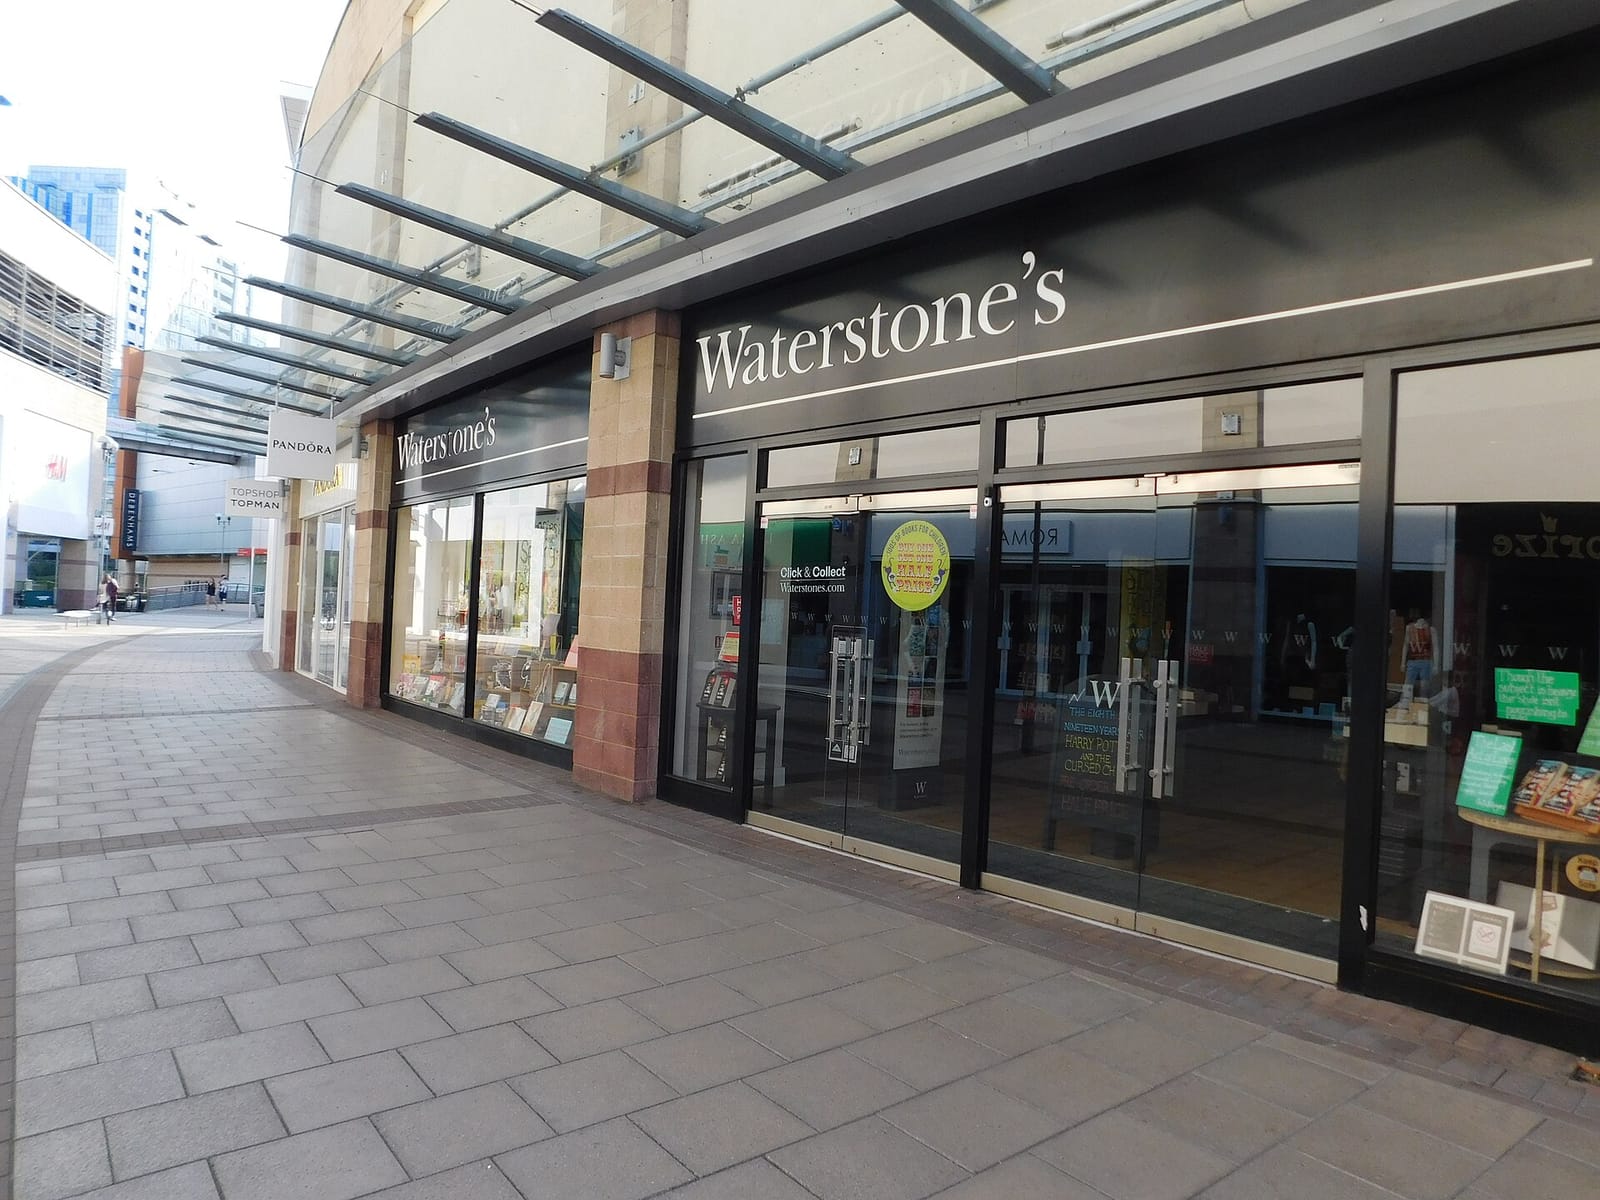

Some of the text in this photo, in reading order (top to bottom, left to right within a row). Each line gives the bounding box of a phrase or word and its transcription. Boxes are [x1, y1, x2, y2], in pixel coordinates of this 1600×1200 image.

[695, 250, 1067, 394] Waterstone's
[397, 406, 496, 471] Waterstone's
[231, 487, 280, 499] TOPSHOP
[230, 498, 280, 509] TOPMAN
[126, 492, 136, 548] DEBENHAMS
[780, 565, 846, 578] Click & Collect
[897, 564, 934, 578] HALF
[780, 582, 845, 593] Waterstones.com
[896, 579, 932, 593] PRICE
[1090, 680, 1121, 709] W
[1069, 706, 1085, 717] THE
[1064, 721, 1100, 734] NINETEEN
[1065, 734, 1094, 750] HARRY
[1080, 752, 1112, 764] AND THE
[1064, 760, 1101, 774] CURSED
